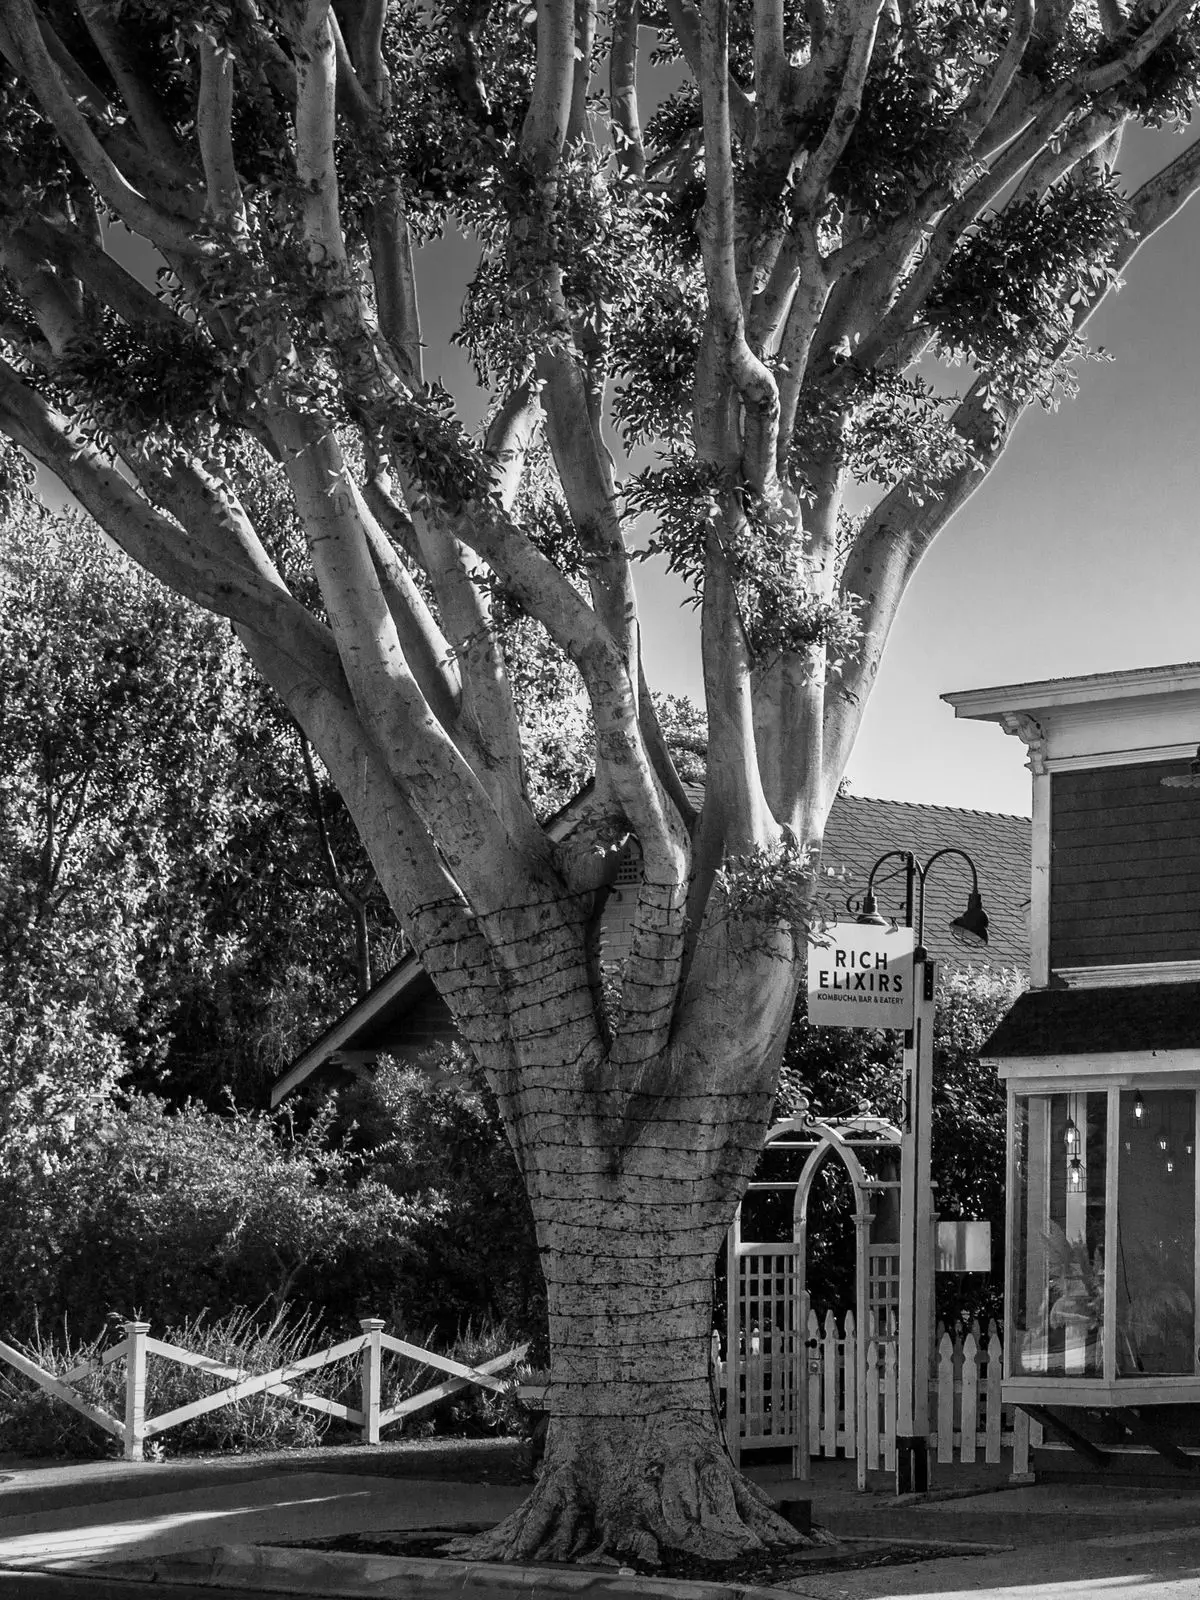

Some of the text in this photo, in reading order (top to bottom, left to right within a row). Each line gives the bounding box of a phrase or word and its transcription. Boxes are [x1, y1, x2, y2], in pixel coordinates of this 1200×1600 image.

[835, 949, 888, 970] RICH
[819, 970, 903, 993] ELIXIRS
[817, 993, 904, 1005] KOMBUCHA BAR & EATERY
